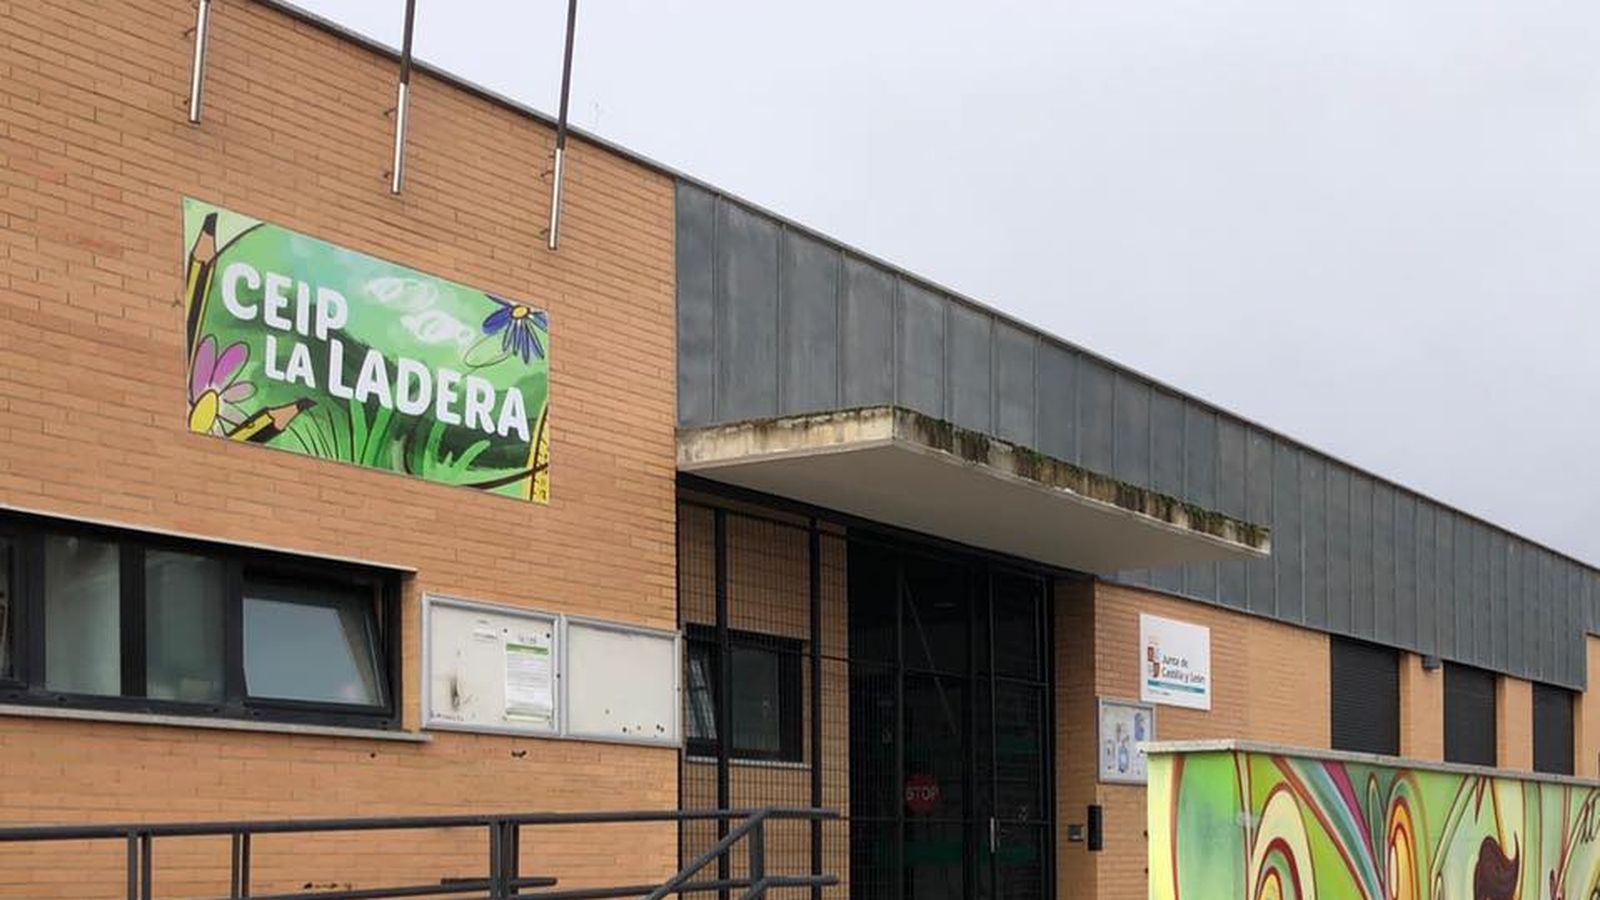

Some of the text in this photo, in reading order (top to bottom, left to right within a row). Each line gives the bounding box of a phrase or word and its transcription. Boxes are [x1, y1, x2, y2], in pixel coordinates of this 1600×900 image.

[222, 262, 347, 340] CEIP
[264, 335, 530, 442] LA LADERA
[1162, 655, 1189, 668] Junta de
[1162, 666, 1184, 680] Castilla
[905, 785, 940, 801] STOP
